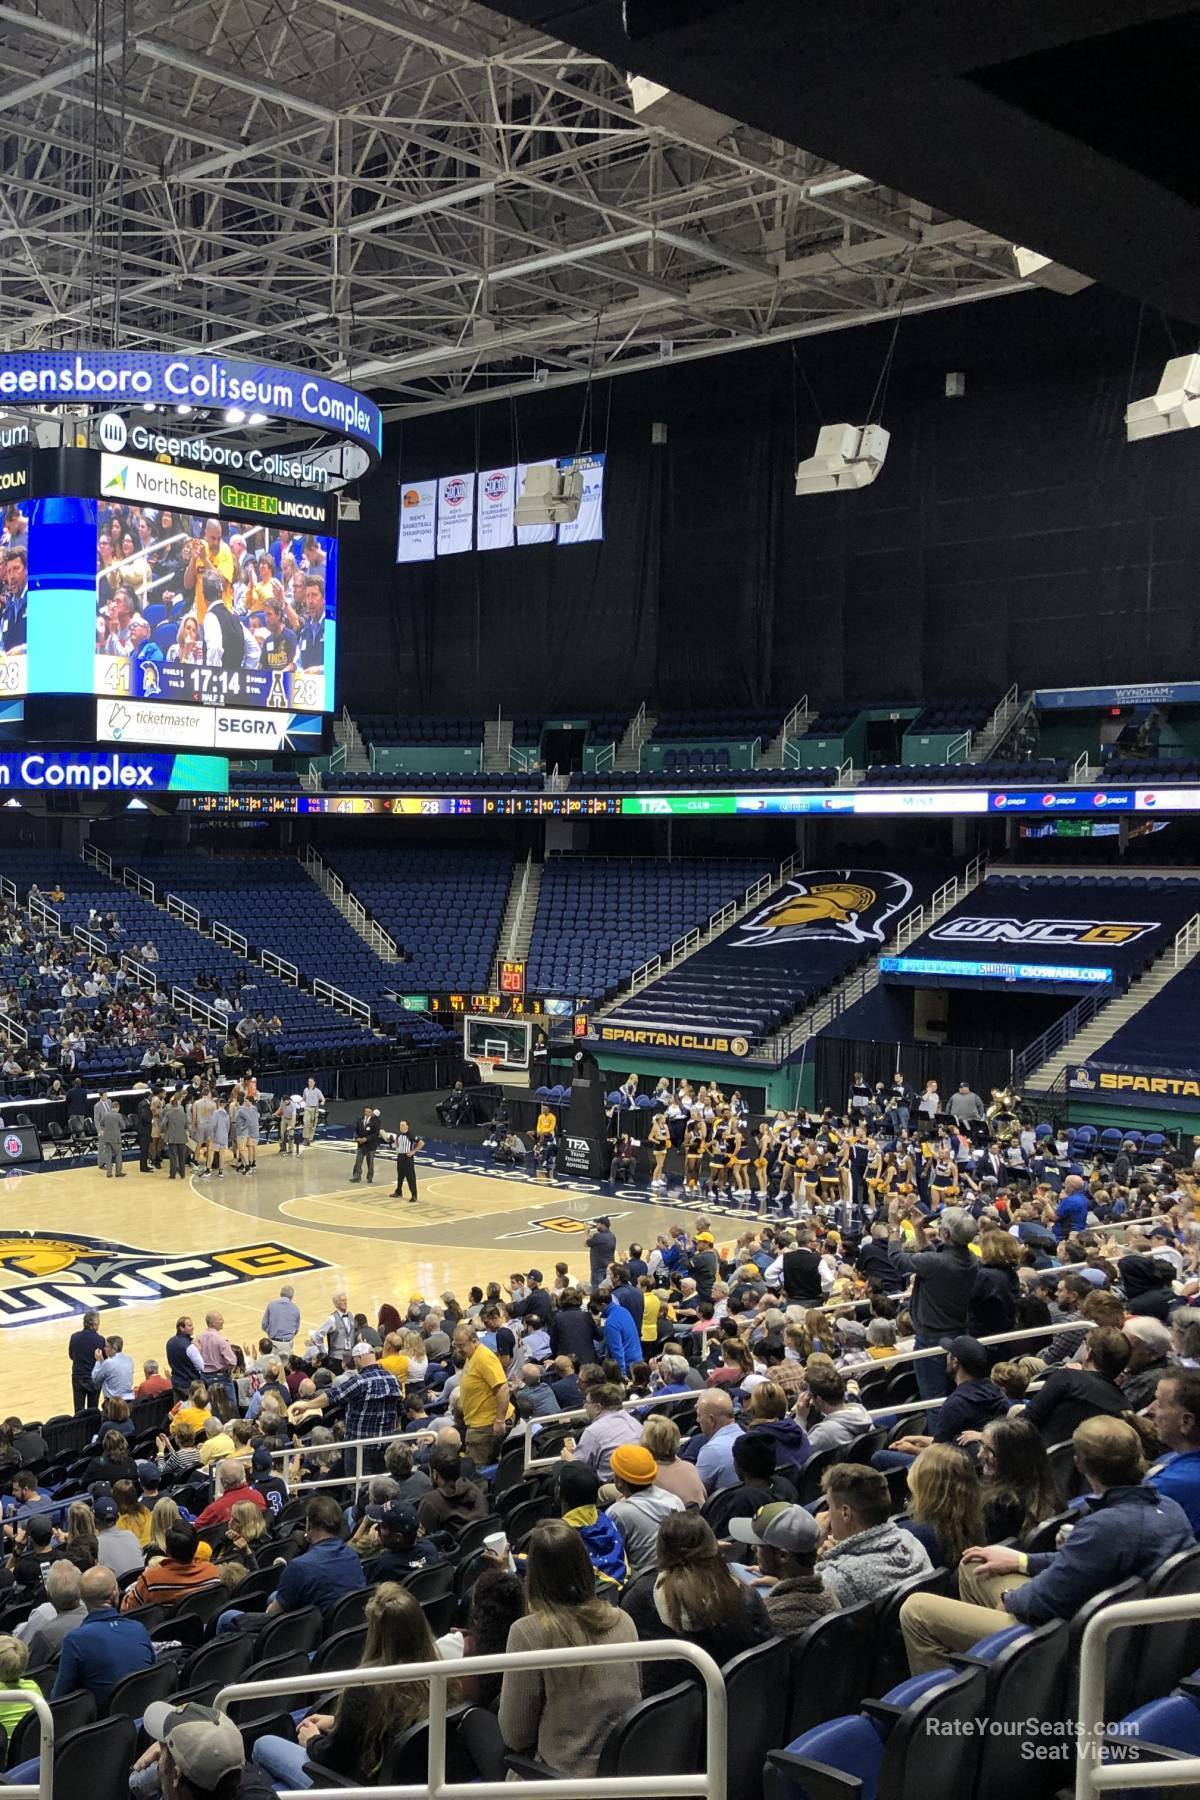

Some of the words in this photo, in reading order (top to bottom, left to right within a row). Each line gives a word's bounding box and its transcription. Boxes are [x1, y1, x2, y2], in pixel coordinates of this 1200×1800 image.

[164, 362, 293, 408] Coliseum
[301, 382, 371, 434] Complex
[132, 427, 243, 469] Greensboro
[249, 455, 329, 483] Coliseum
[136, 472, 217, 502] NorthState
[220, 485, 278, 515] GREEN
[278, 499, 325, 522] LINCOLN
[104, 661, 130, 690] 41
[191, 668, 240, 694] 17:14
[294, 678, 317, 706] 28
[1115, 688, 1170, 697] WYNDHAM
[136, 711, 200, 728] ticketmaster
[218, 718, 277, 735] SEGRA
[21, 753, 154, 790] Complex
[421, 801, 439, 814] 28
[542, 801, 553, 810] 10
[570, 801, 580, 810] 20
[596, 801, 606, 810] 21
[639, 799, 673, 813] TFA
[779, 802, 810, 812] Corona
[1007, 798, 1026, 806] pepsi
[1056, 797, 1075, 805] pepsi
[938, 920, 1148, 945] UNCG
[503, 963, 523, 972] 17:14
[503, 974, 520, 989] 20
[602, 1027, 678, 1048] SPARTAN
[681, 1035, 729, 1052] CLUB
[1099, 1072, 1200, 1097] SPARTA
[566, 1137, 590, 1151] TFA
[615, 1190, 808, 1226] Coliseu
